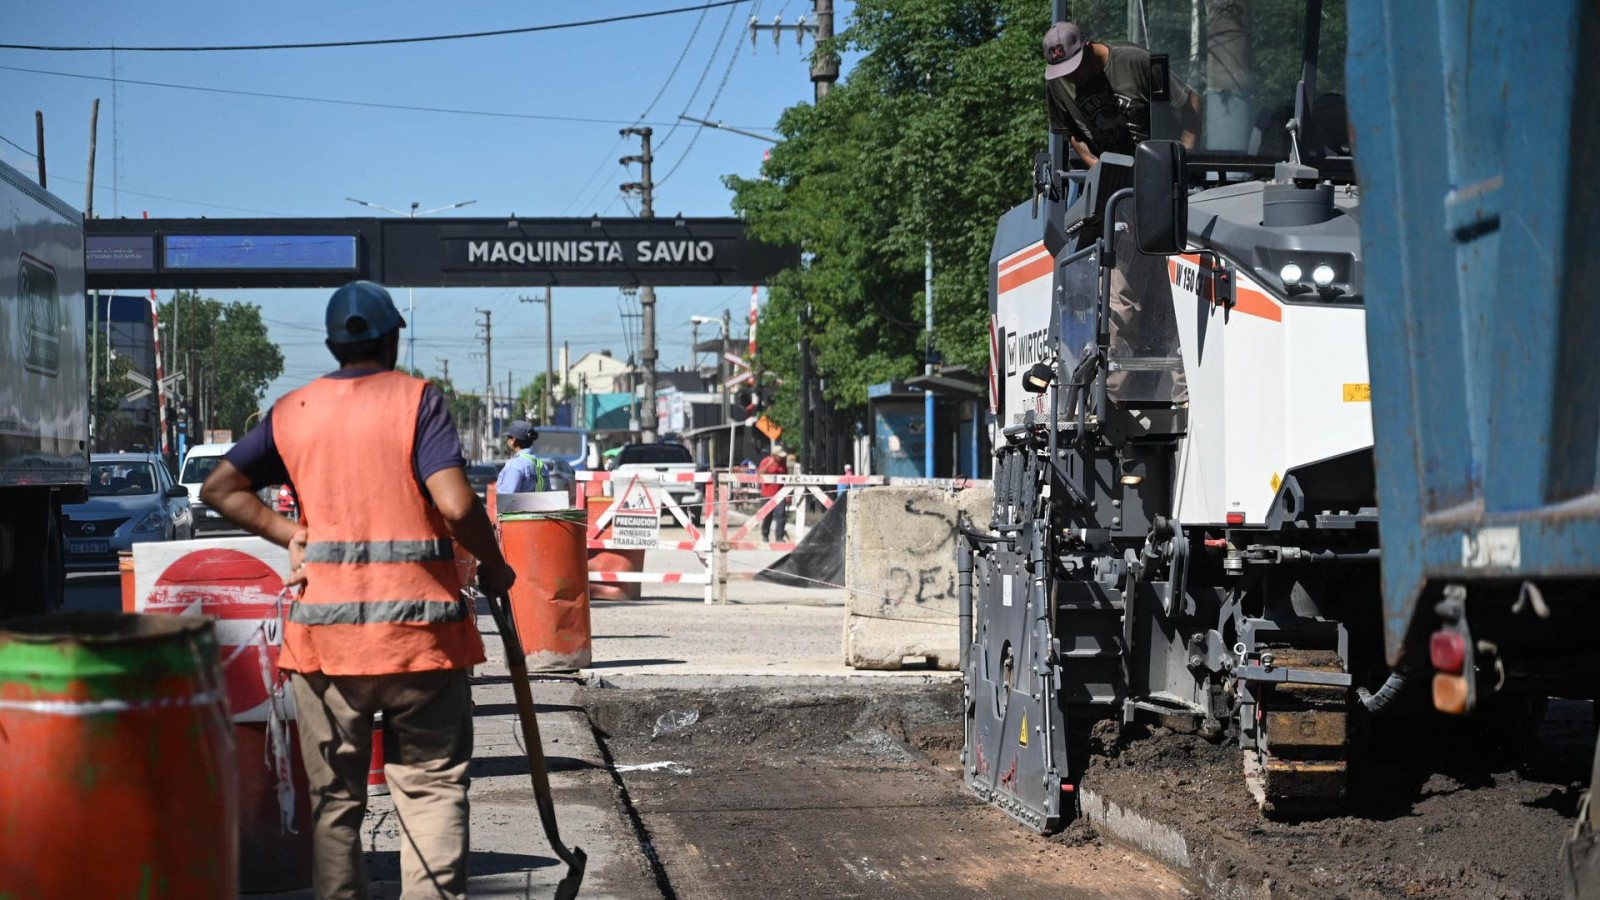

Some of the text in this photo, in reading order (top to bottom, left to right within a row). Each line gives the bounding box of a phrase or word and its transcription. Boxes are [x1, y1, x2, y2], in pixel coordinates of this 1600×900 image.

[468, 240, 714, 264] MAQUINISTA SAVIO
[1184, 266, 1195, 293] 150
[618, 529, 651, 537] HOMBRES
[613, 538, 656, 546] TRABAJANDO
